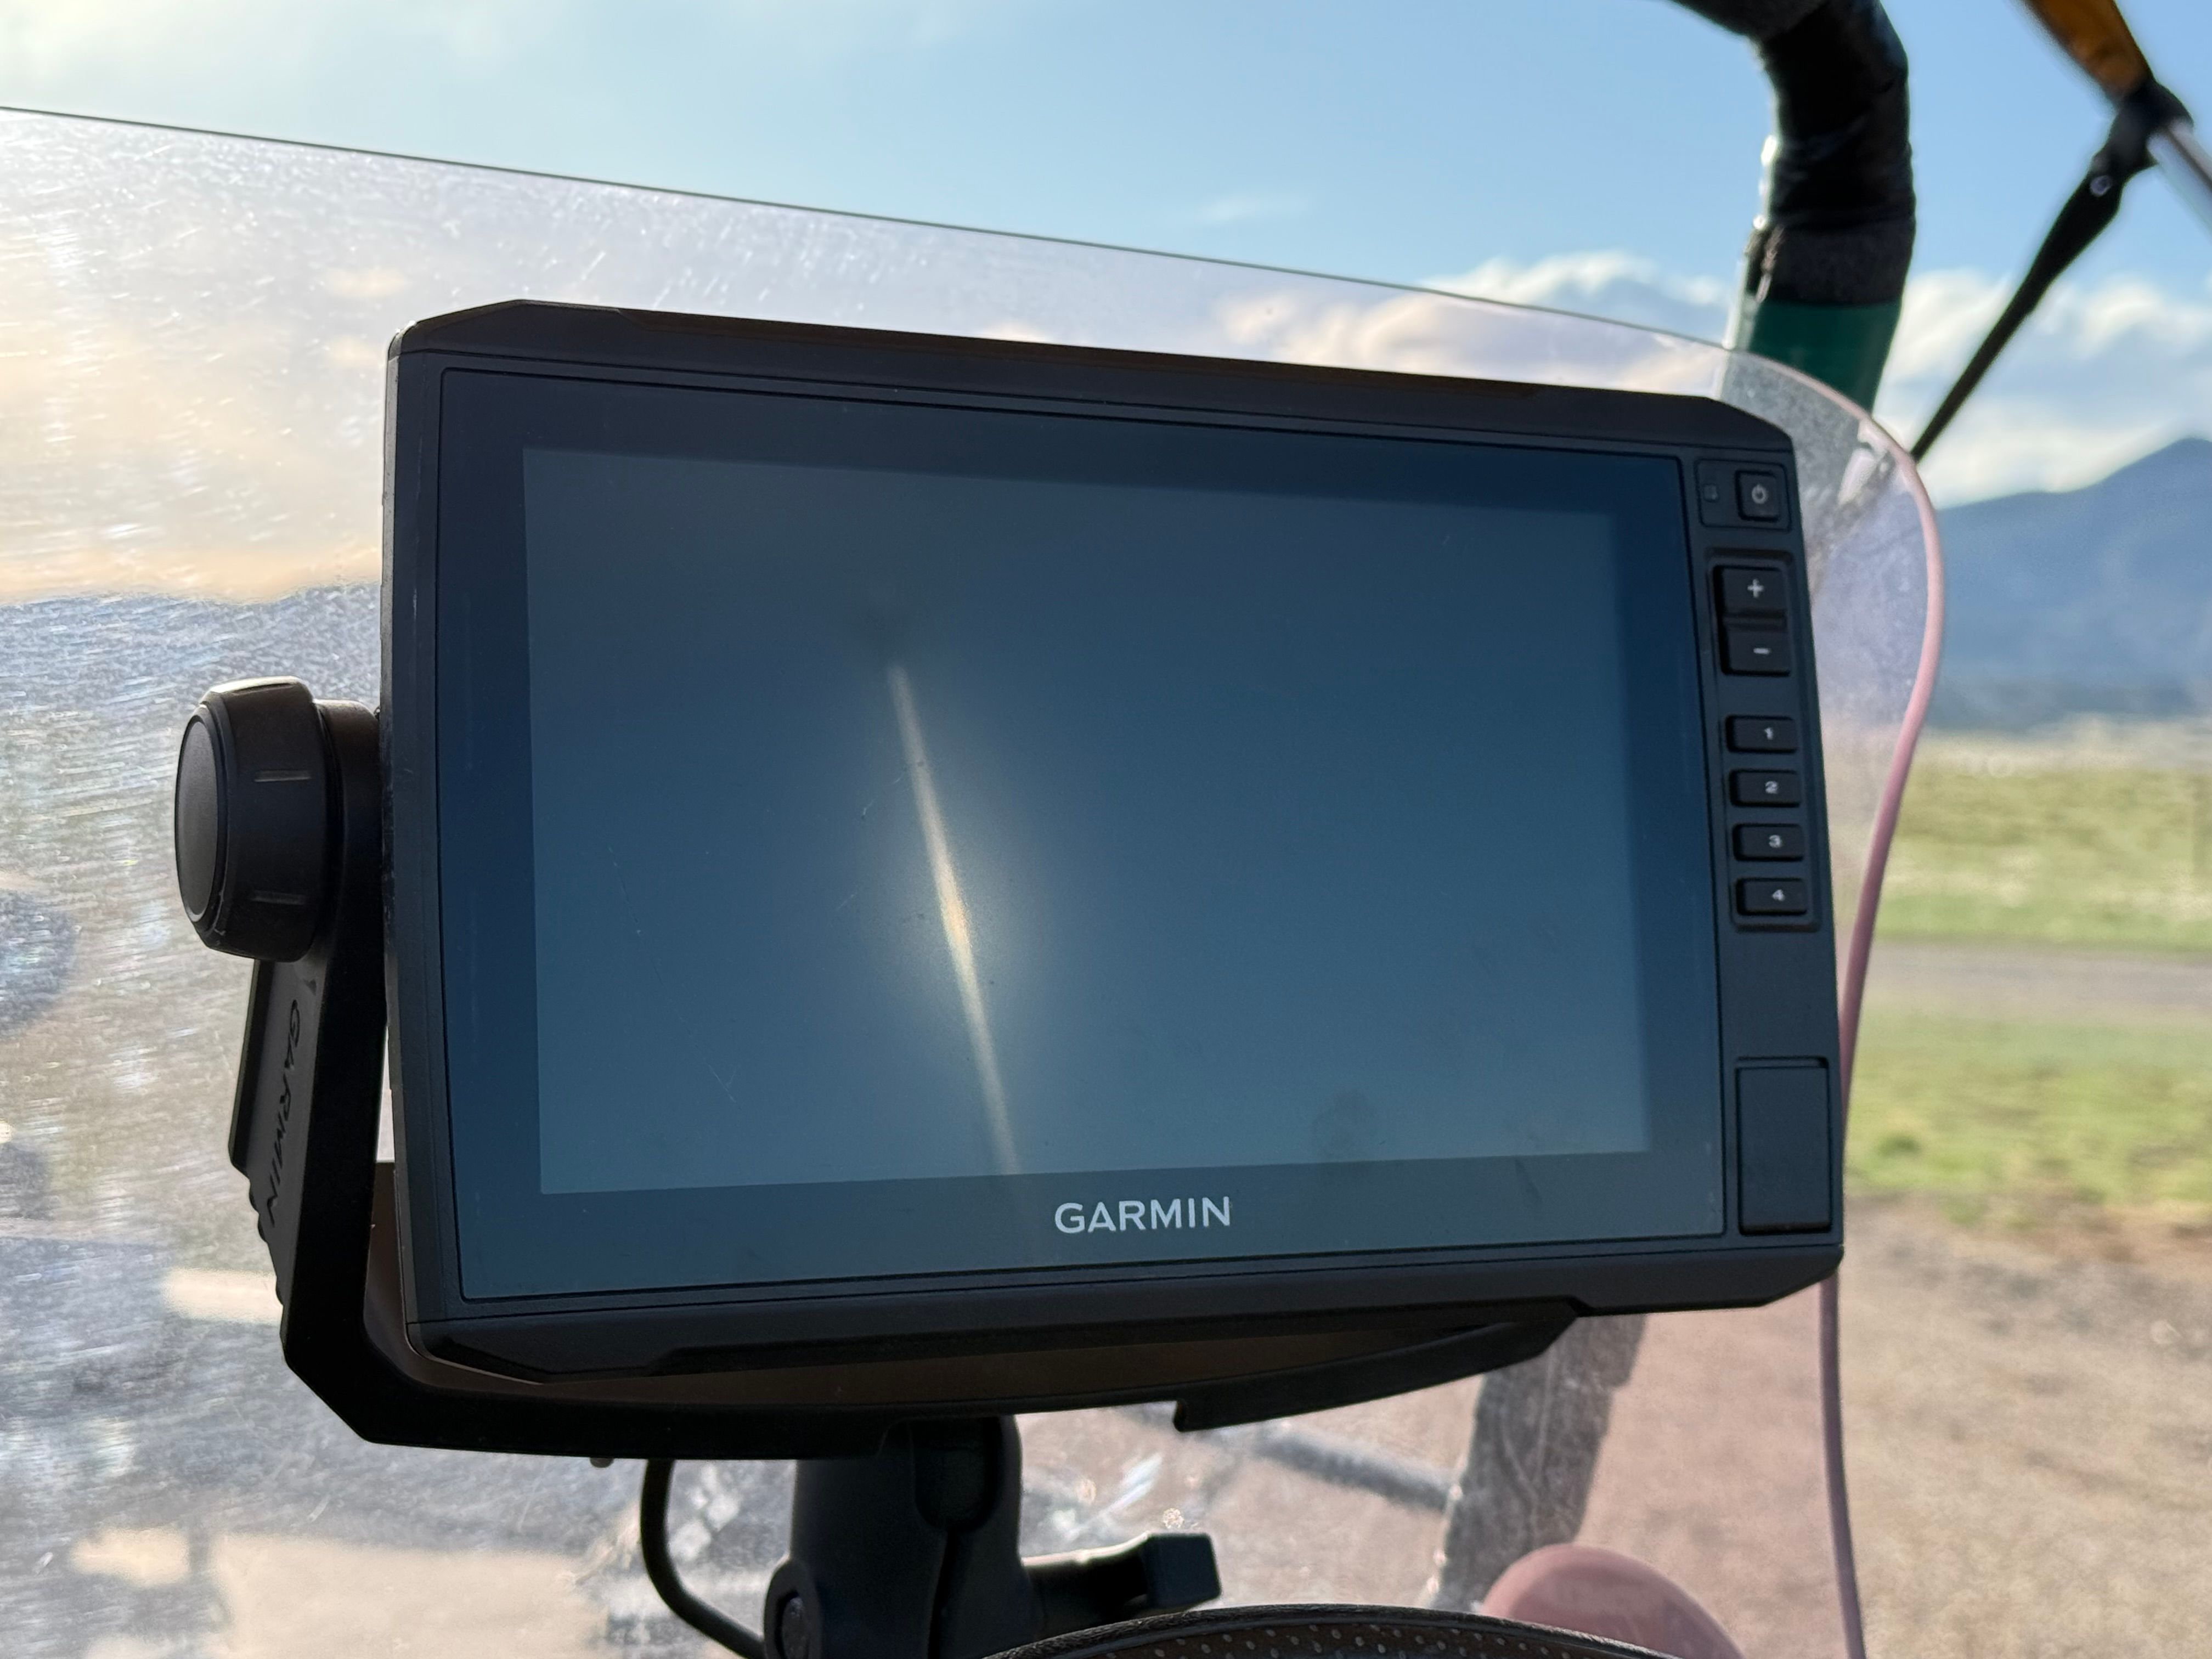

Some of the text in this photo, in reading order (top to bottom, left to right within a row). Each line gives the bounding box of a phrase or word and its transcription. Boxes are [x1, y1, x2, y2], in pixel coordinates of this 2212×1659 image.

[1764, 727, 1773, 740] 1
[1765, 781, 1778, 794] 2
[1769, 835, 1782, 848] 3
[1772, 889, 1785, 901] 4
[267, 1000, 300, 1229] GARMIN
[1054, 1196, 1231, 1234] GARMIN
